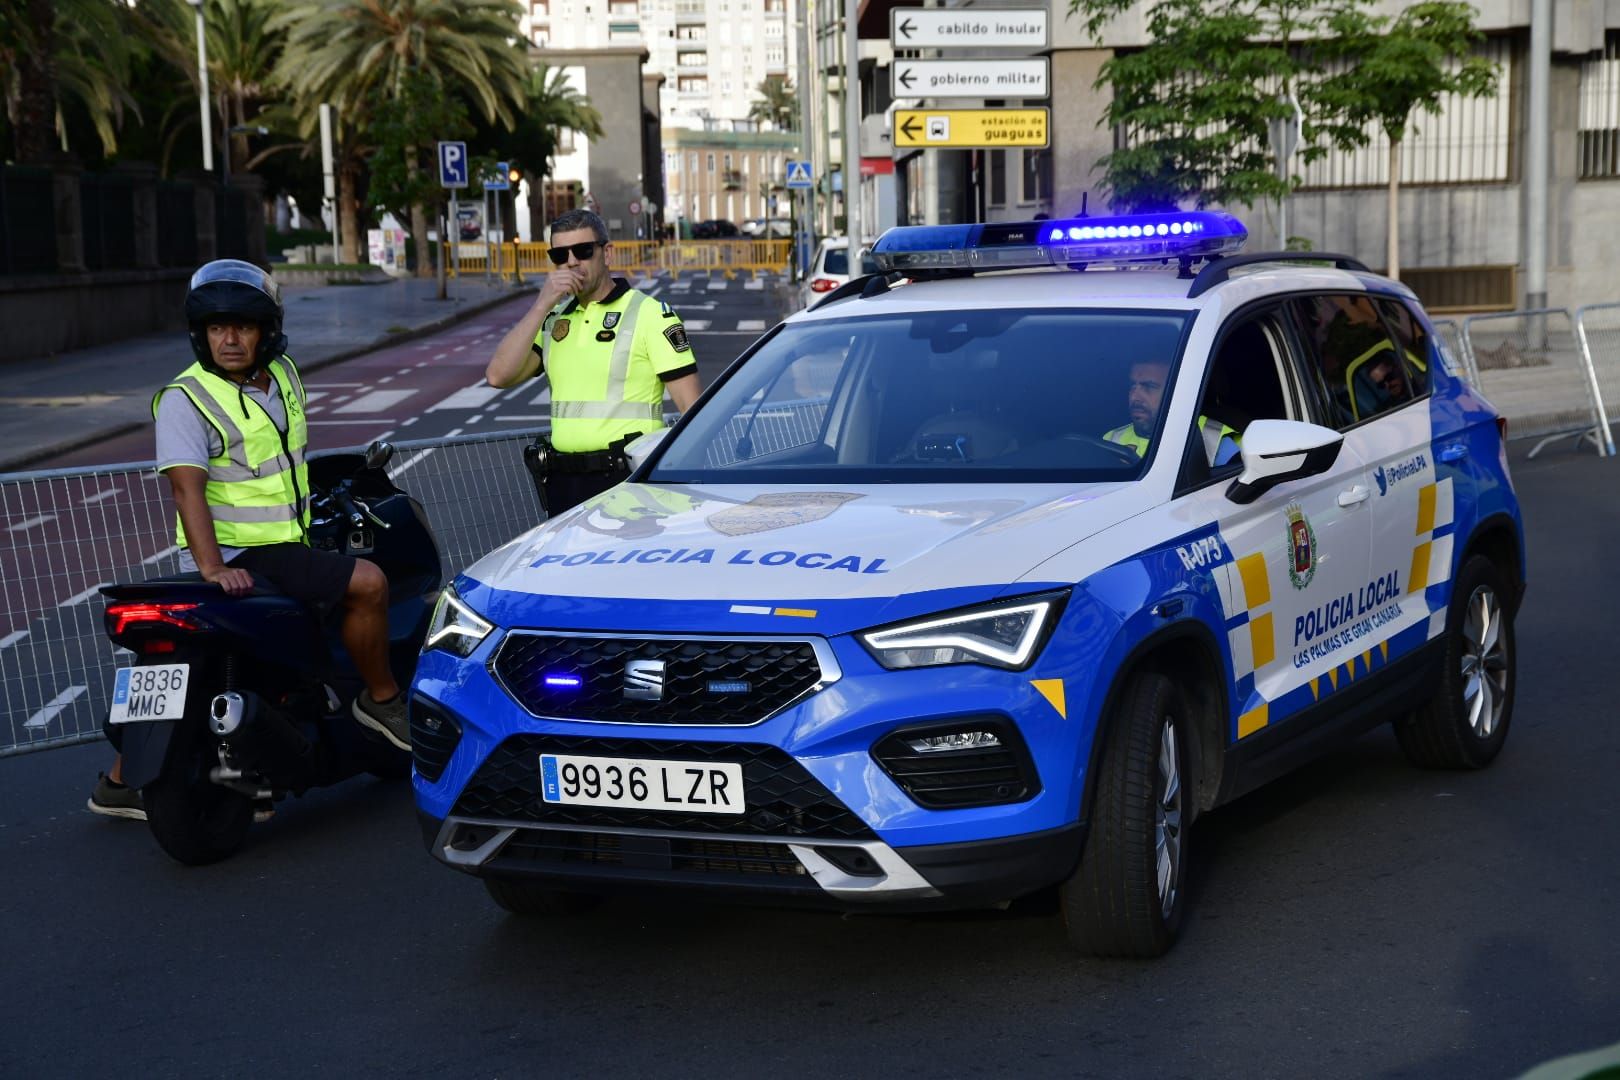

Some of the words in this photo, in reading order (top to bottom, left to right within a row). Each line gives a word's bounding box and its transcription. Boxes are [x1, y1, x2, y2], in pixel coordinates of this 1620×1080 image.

[937, 24, 988, 34] cabildo
[996, 23, 1041, 34] insular
[930, 73, 989, 86] gobierno
[997, 72, 1041, 84] militar
[1031, 117, 1042, 125] de
[985, 129, 1042, 140] guaguas
[529, 548, 716, 568] POLICIA
[727, 549, 890, 574] LOCAL
[1176, 535, 1222, 571] R-073
[1294, 592, 1353, 647] POLICIA
[1357, 569, 1400, 616] LOCAL
[1293, 648, 1311, 668] LAS
[1310, 634, 1342, 660] PALMAS
[1340, 627, 1353, 645] DE
[1351, 617, 1374, 639] GRAN
[1371, 603, 1403, 628] CANARIA
[131, 668, 183, 692] 3836
[127, 694, 167, 718] MMG
[548, 784, 555, 794] E
[561, 763, 649, 801] 9936
[661, 767, 731, 805] LZR
